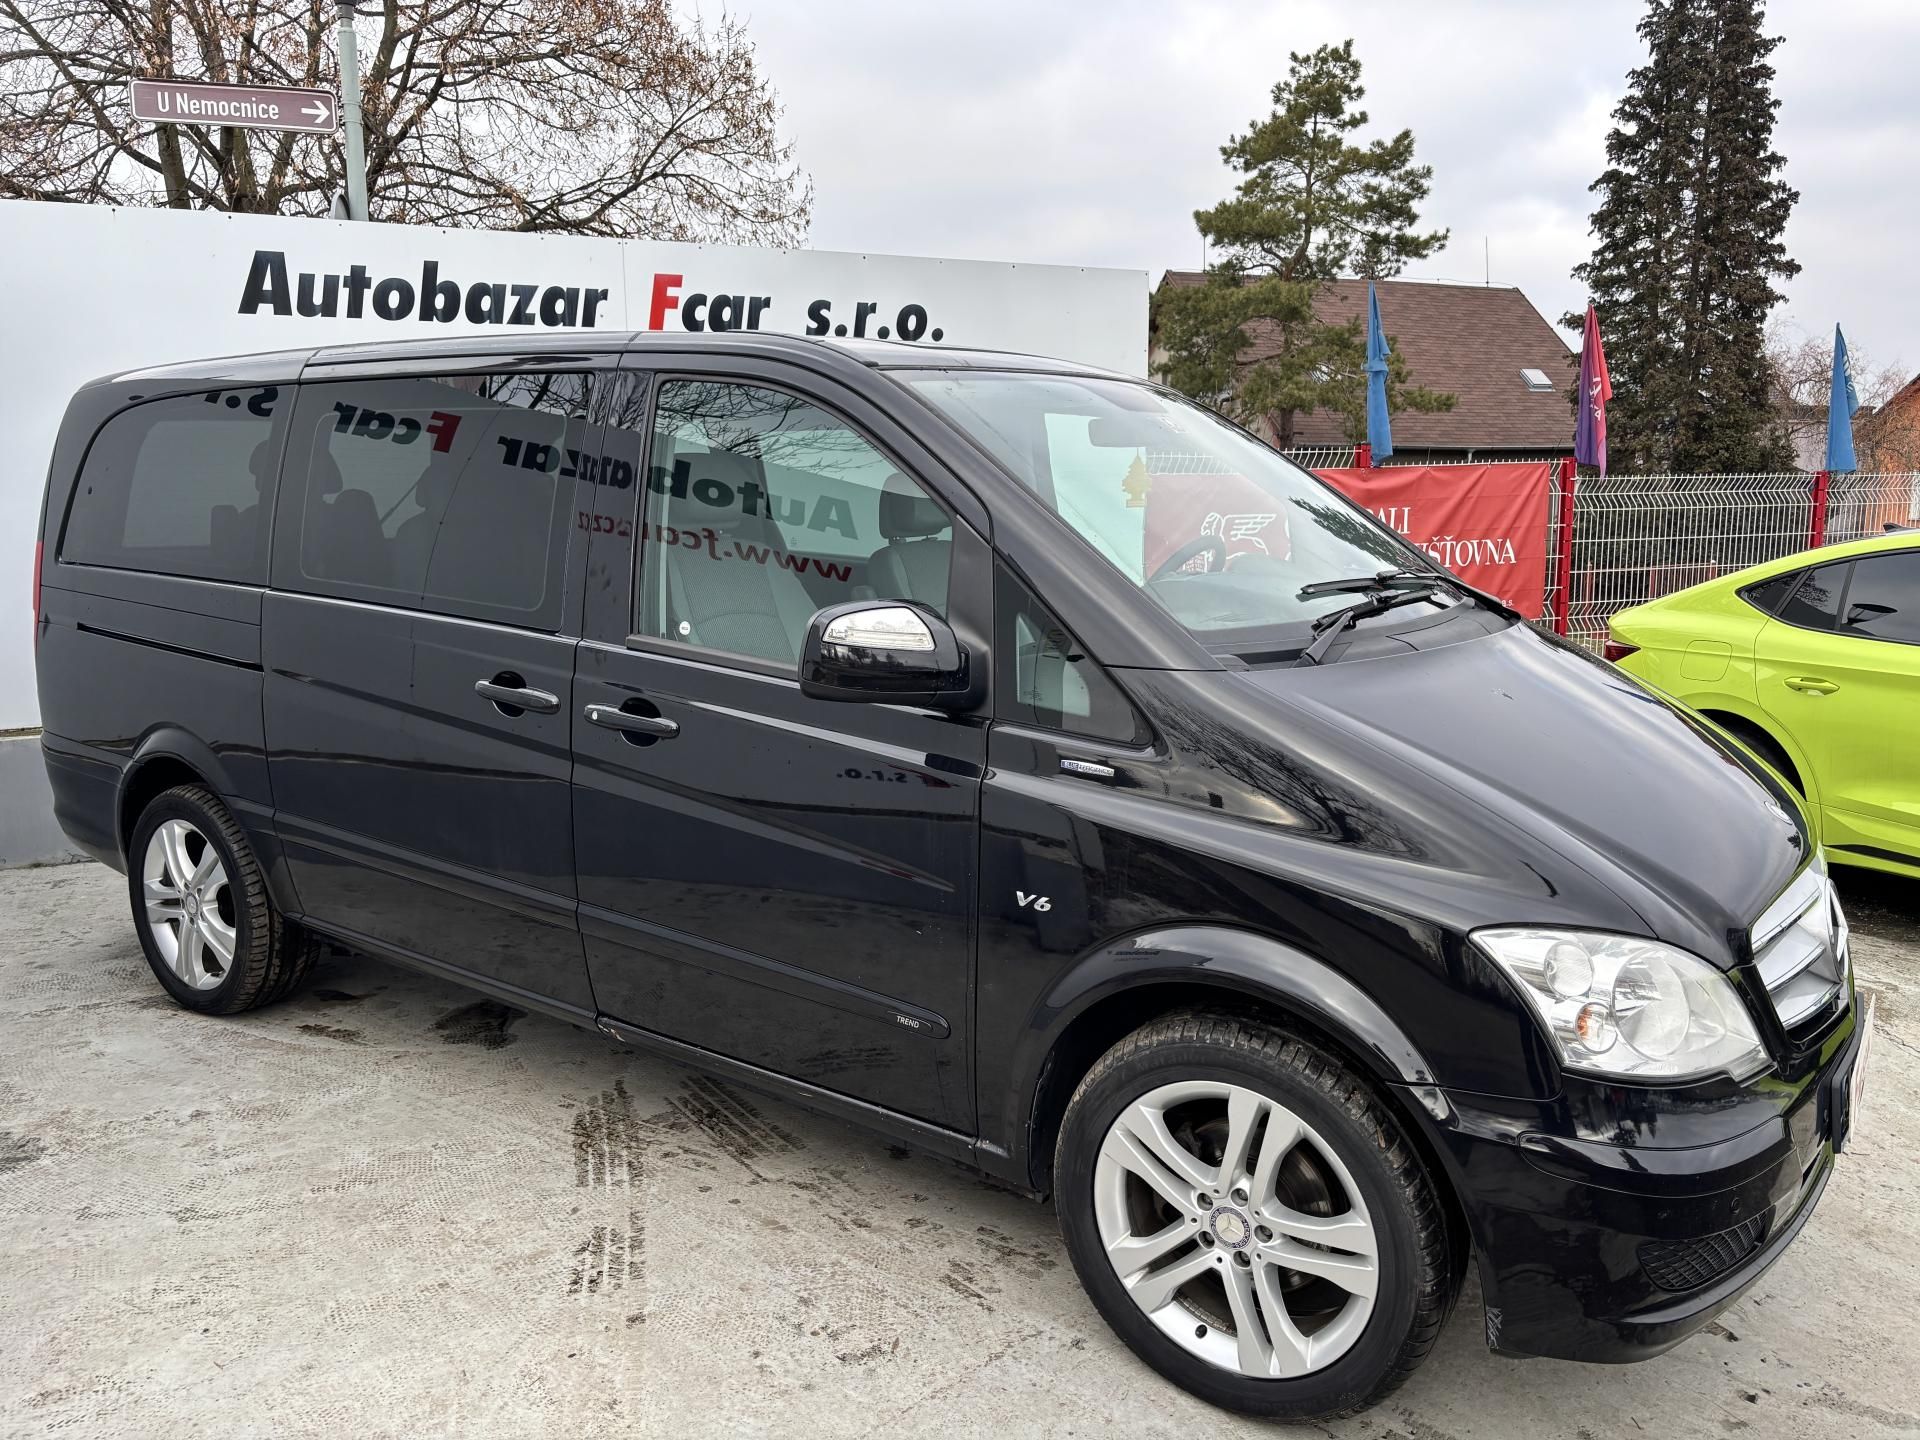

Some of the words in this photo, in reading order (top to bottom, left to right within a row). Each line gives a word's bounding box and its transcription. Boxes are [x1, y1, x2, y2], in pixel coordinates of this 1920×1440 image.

[157, 92, 170, 112] U
[176, 92, 280, 119] Nemocnice
[238, 249, 608, 327] Autobazar
[648, 273, 771, 331] Fcar
[806, 297, 945, 340] s.r.o.
[1015, 890, 1053, 912] V6
[896, 1015, 920, 1029] TREND
